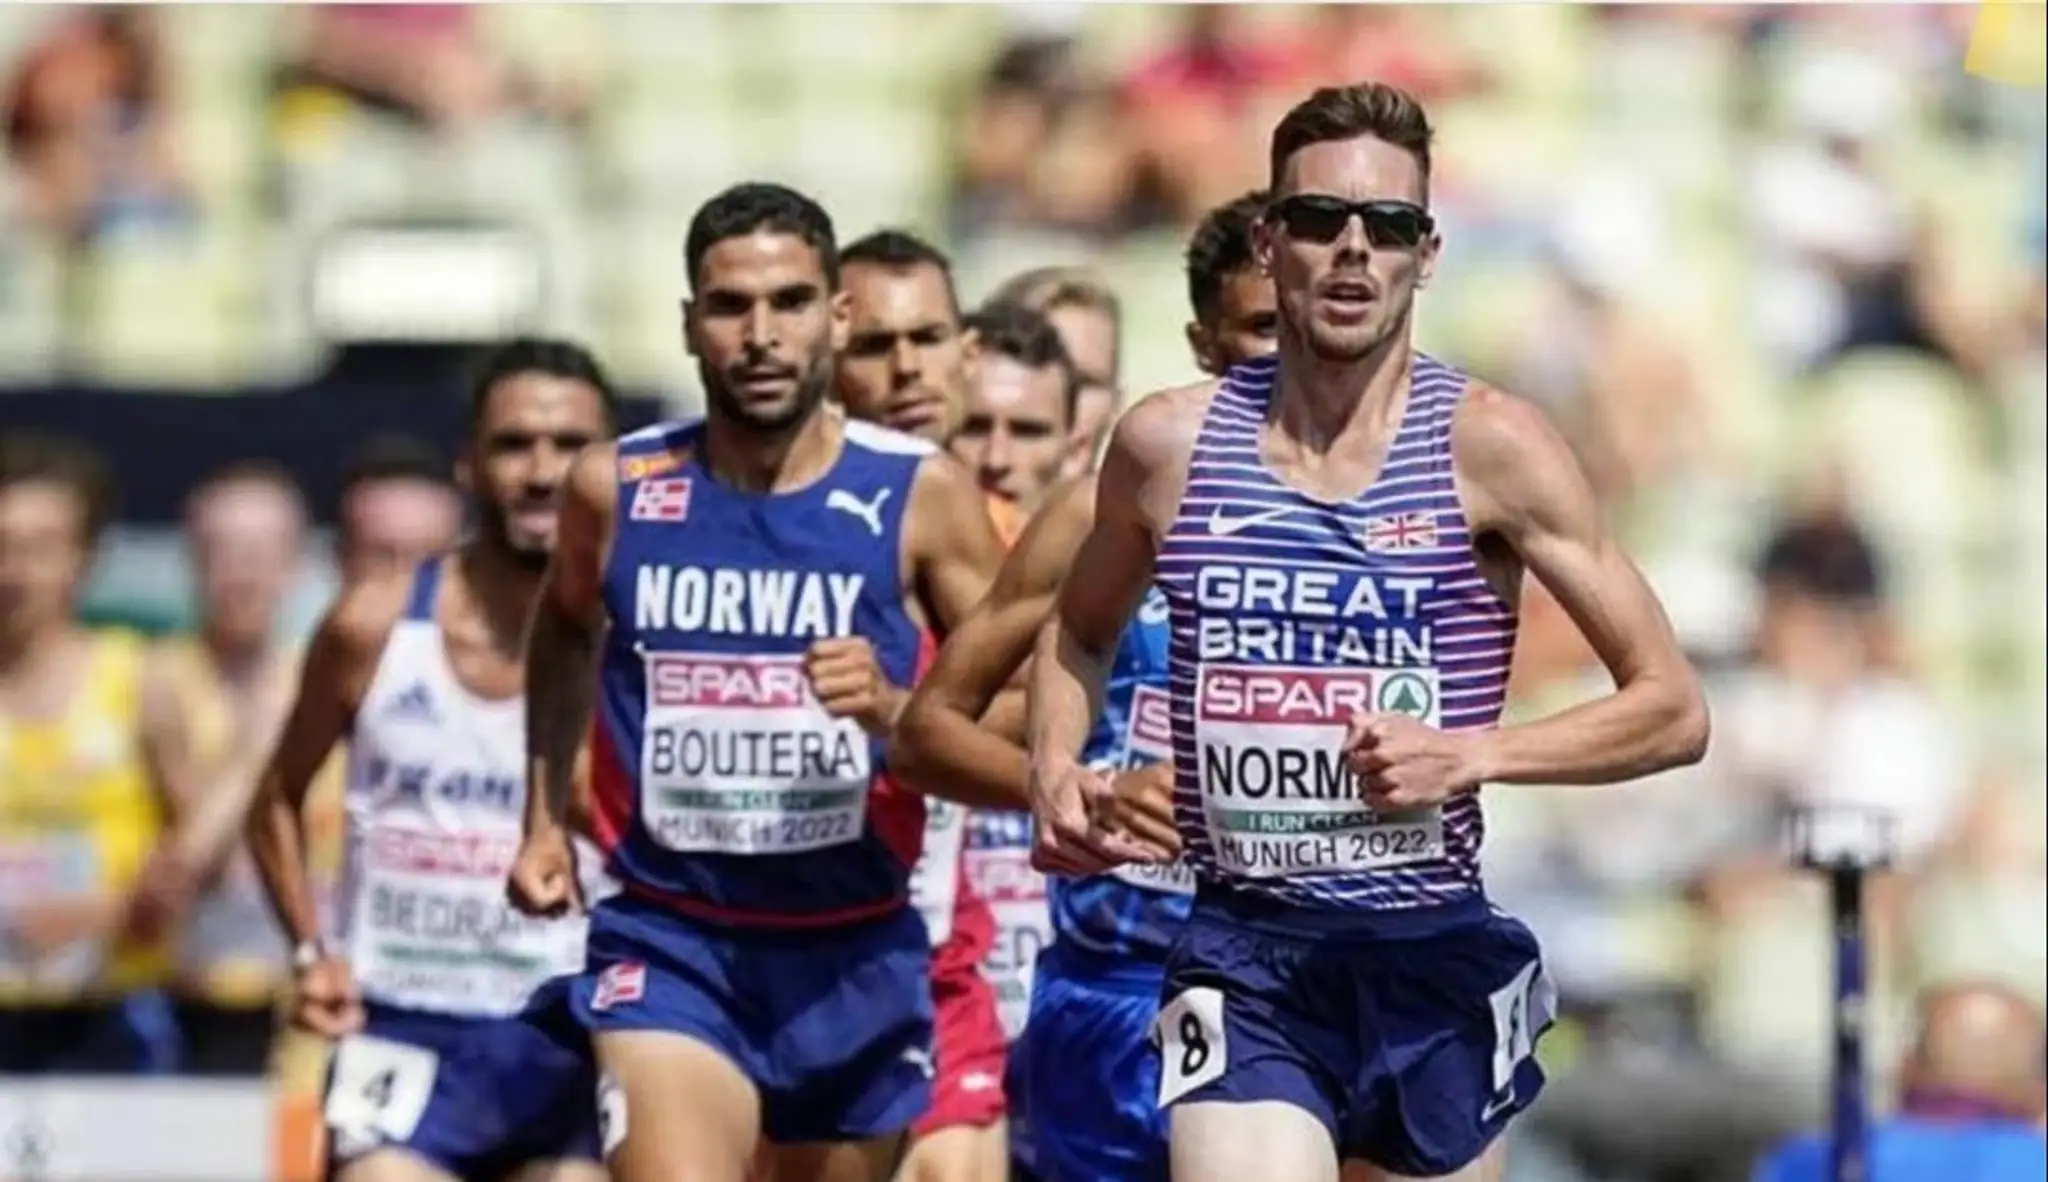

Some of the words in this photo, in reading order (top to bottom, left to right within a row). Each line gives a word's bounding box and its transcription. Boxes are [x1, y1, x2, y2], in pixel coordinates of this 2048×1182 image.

[635, 565, 864, 638] NORWAY
[1198, 566, 1434, 619] GREAT
[1199, 617, 1433, 666] BRITAIN
[655, 664, 798, 707] SPAR
[1204, 674, 1368, 718] SPAR
[651, 728, 861, 778] BOUTERA
[1205, 744, 1362, 800] NORM
[781, 811, 850, 845] 2022
[1260, 812, 1305, 832] RUN
[1219, 835, 1339, 868] MUNICH
[1350, 829, 1428, 862] 2022
[1180, 1011, 1210, 1078] 8
[359, 1062, 399, 1111] 4
